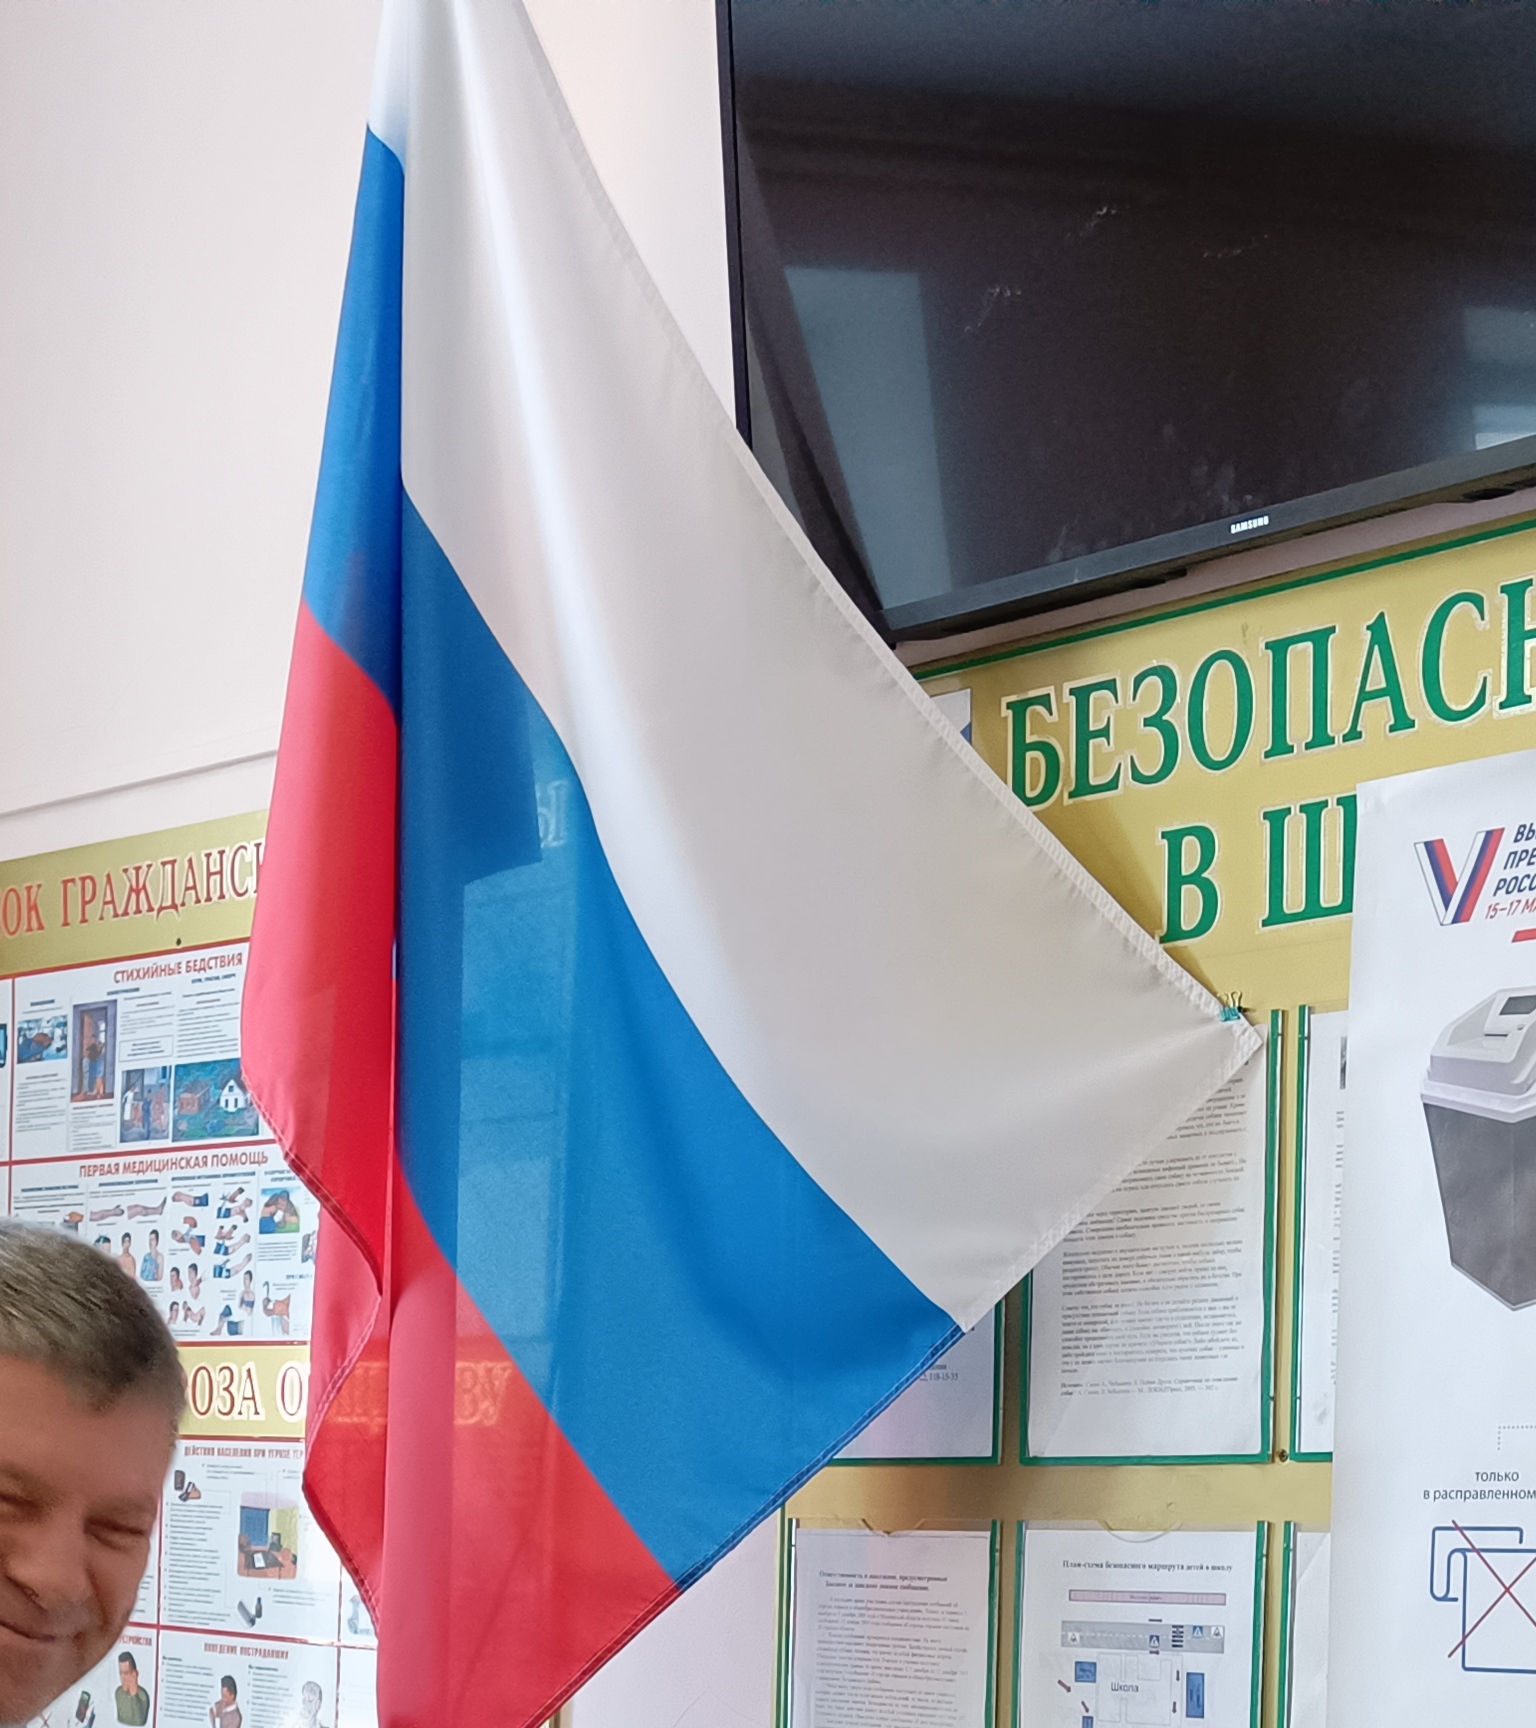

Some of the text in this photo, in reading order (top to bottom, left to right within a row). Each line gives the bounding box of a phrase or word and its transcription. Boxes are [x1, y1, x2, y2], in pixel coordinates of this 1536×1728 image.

[1230, 515, 1269, 534] SAMSUNG
[1159, 823, 1219, 945] В
[114, 962, 182, 983] СТИХИЙНЫЕ
[185, 953, 243, 973] БЕДСТВИЯ
[79, 1151, 268, 1178] ПЕРВАЯ МЕДИЦИНСКАЯ ПОМОЩЬ
[1475, 1471, 1520, 1482] только
[1423, 1489, 1430, 1500] в
[1433, 1489, 1536, 1502] расправленном
[1063, 1560, 1104, 1570] План-схема
[1148, 1562, 1184, 1572] маршрута
[1110, 1681, 1140, 1693] Школа
